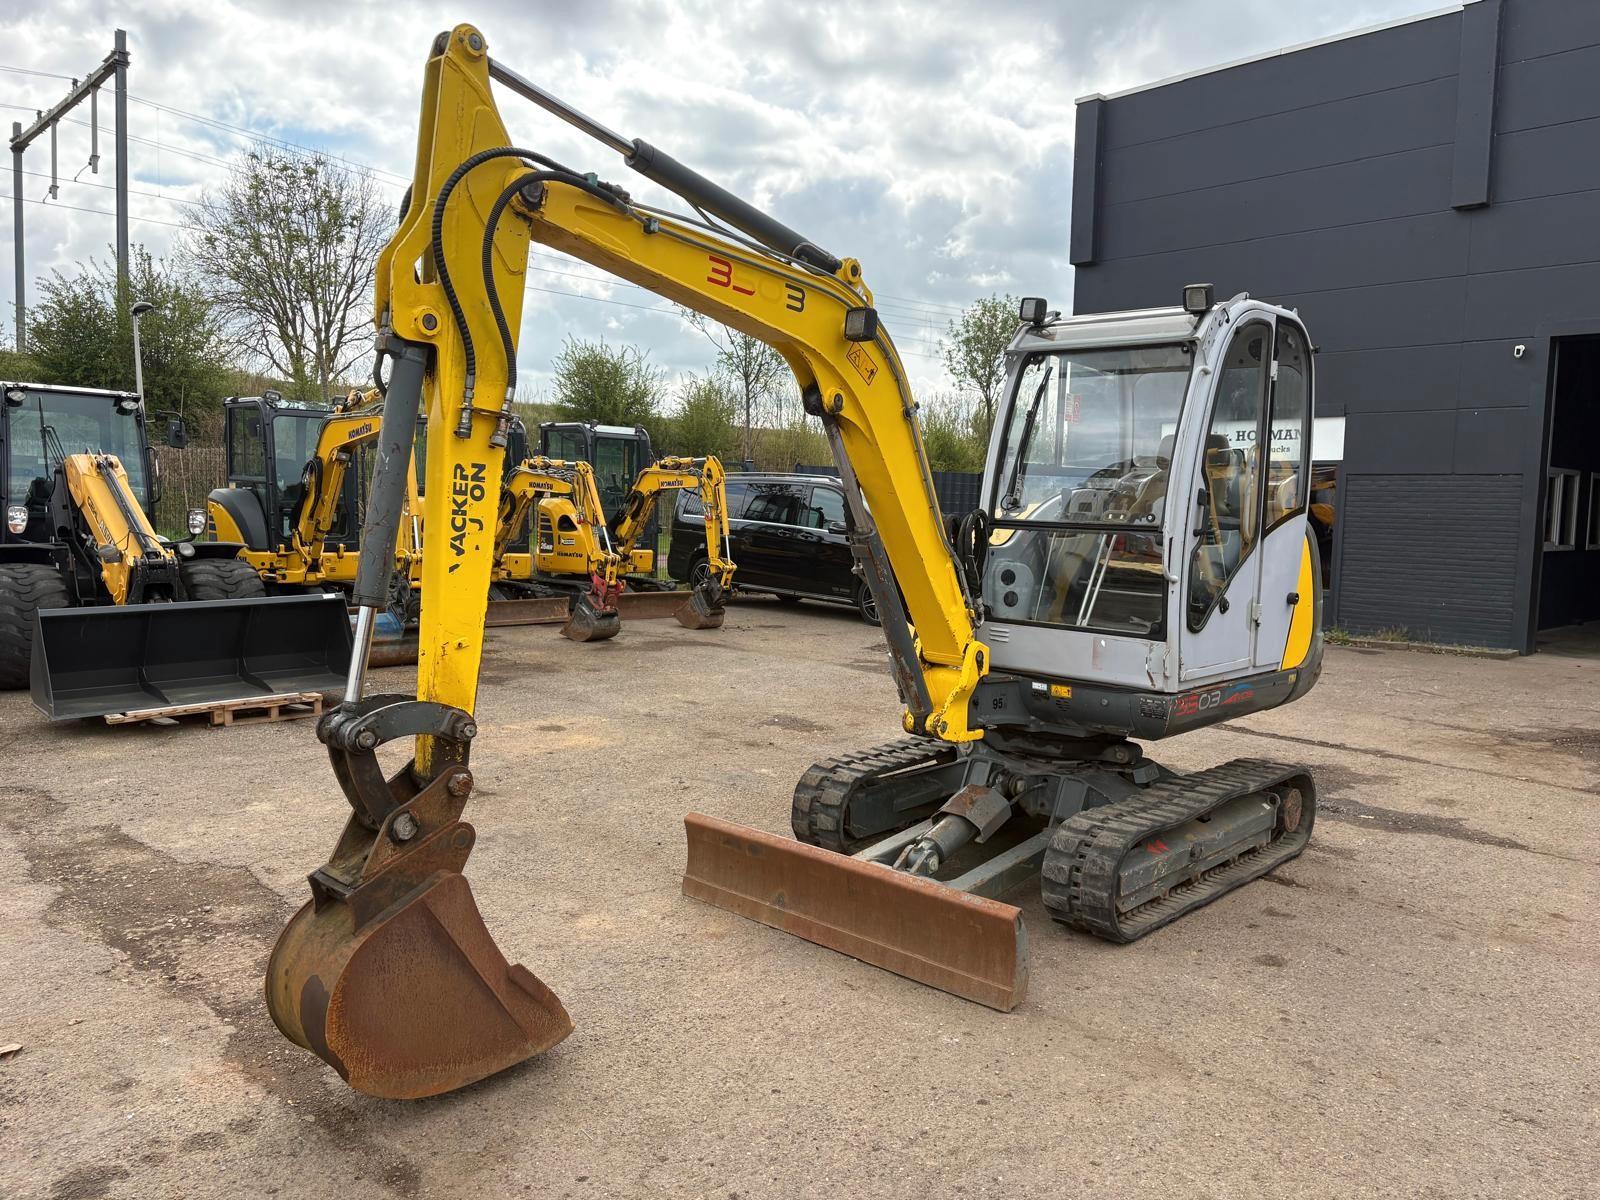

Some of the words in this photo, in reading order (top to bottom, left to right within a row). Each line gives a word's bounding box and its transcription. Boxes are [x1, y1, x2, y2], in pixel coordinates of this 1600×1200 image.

[348, 422, 372, 440] KOMATSU
[1235, 429, 1301, 442] HOMAN
[528, 481, 554, 490] KOMATSU
[660, 477, 684, 487] KOMATSU
[556, 551, 584, 559] KOMATSU
